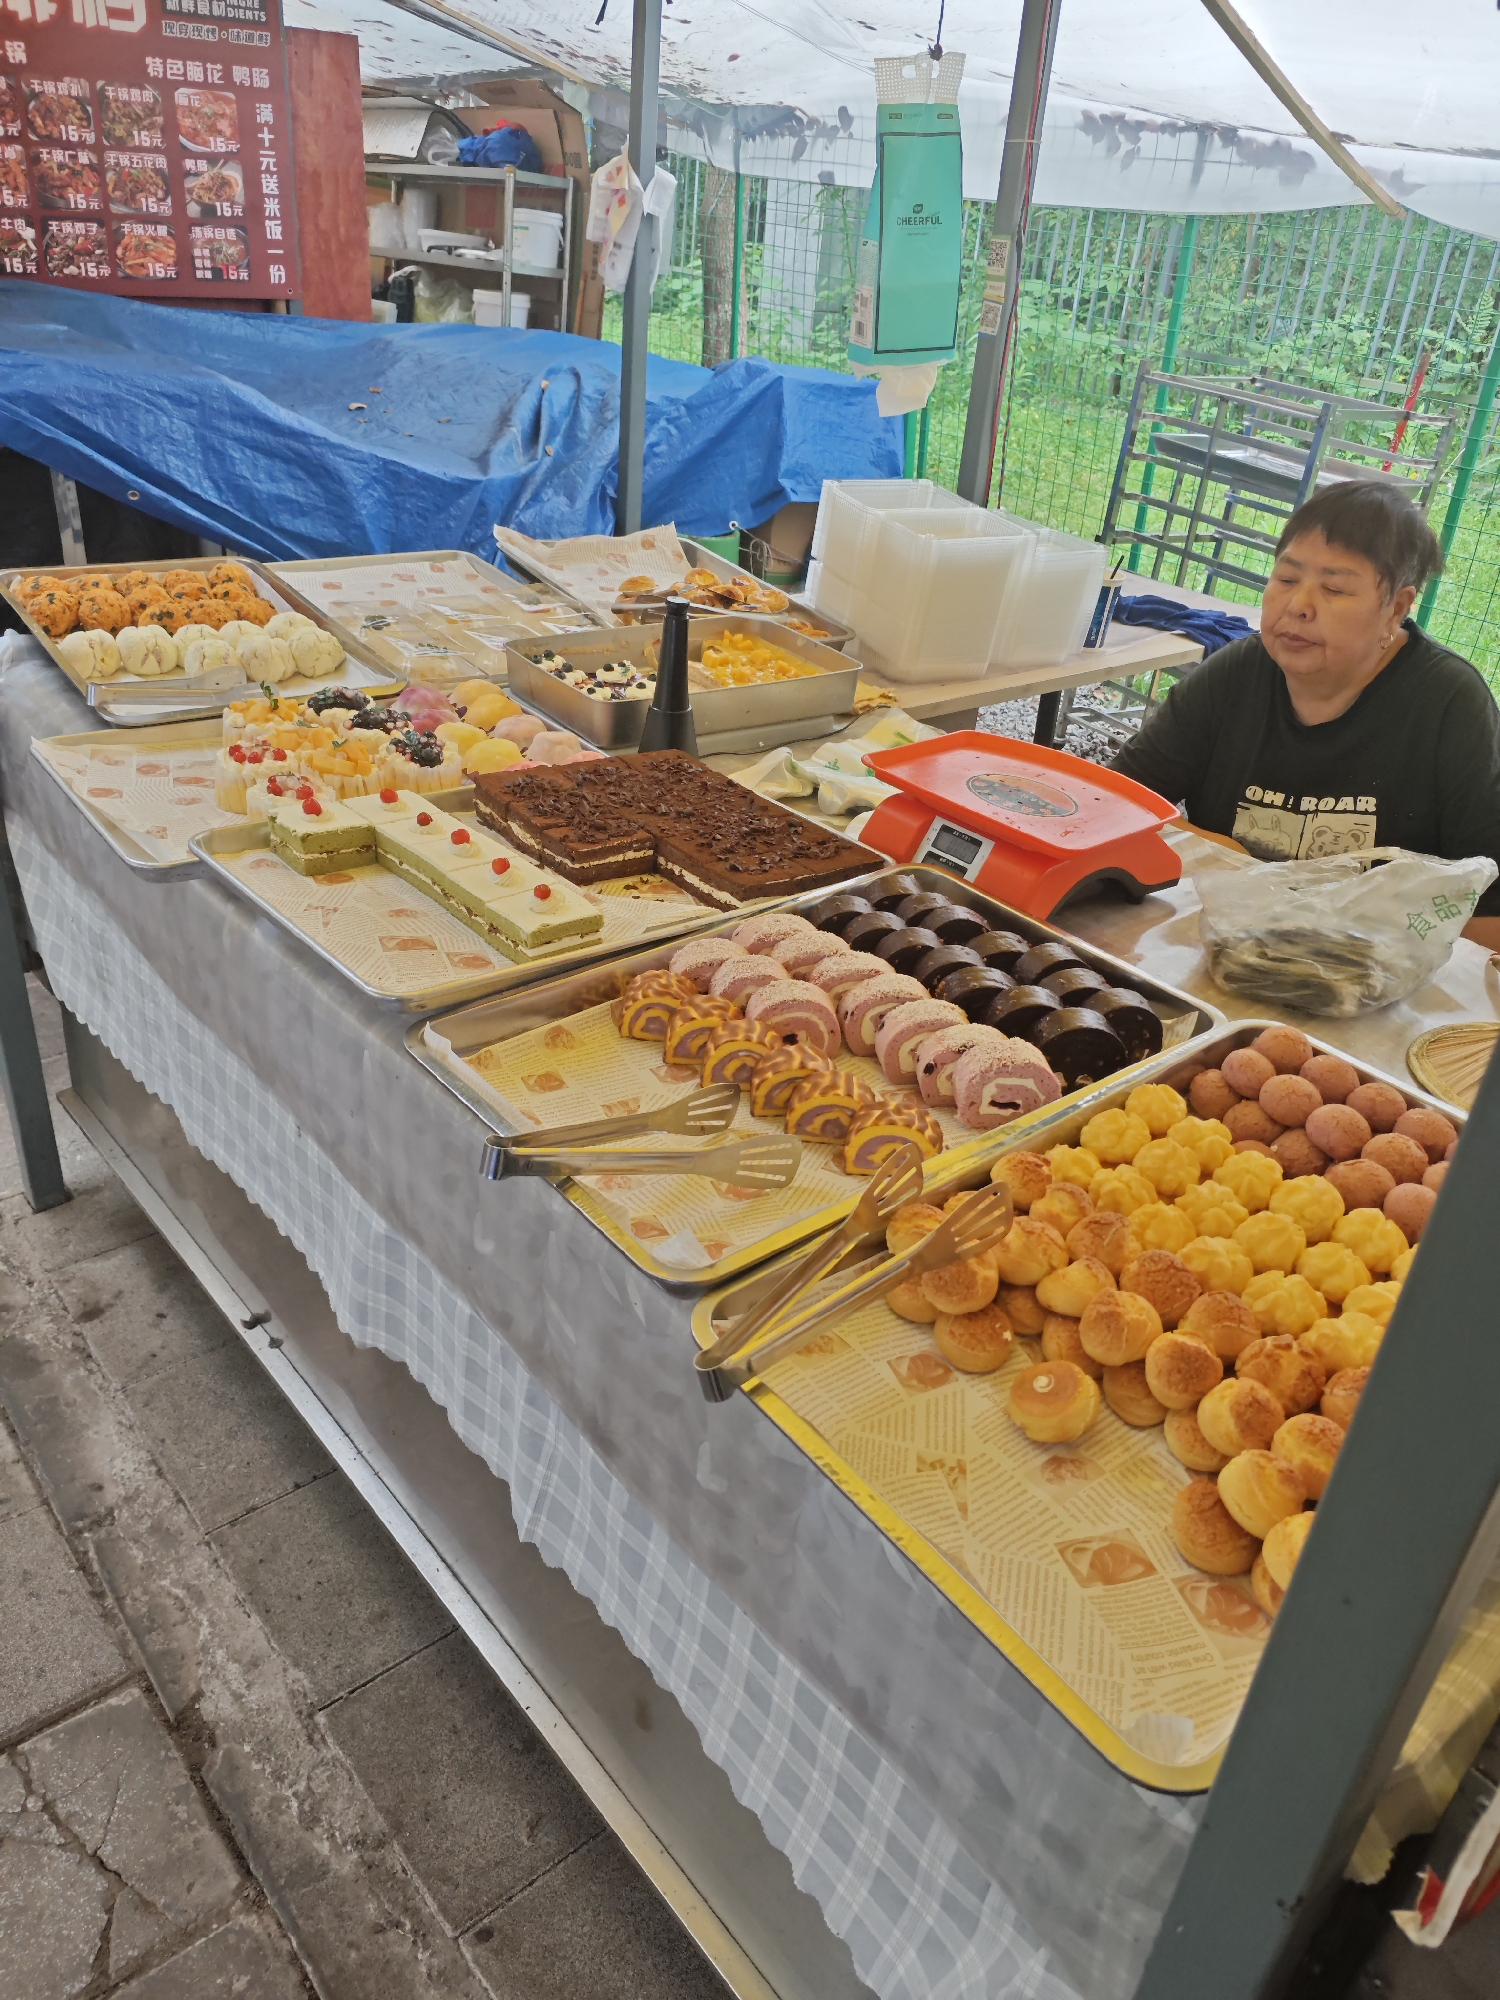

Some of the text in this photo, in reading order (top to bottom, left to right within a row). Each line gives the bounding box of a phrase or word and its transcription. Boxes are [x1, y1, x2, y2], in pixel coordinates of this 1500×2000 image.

[227, 7, 267, 21] DIENTS
[0, 41, 27, 64] 锅
[146, 57, 270, 89] 特色脑花 鸭肠
[105, 86, 154, 103] 干锅鸡肉
[133, 130, 162, 147] 15元
[106, 153, 167, 169] 干锅五花肉
[0, 189, 28, 206] 5元
[68, 193, 101, 209] 15元
[255, 103, 286, 284] 满十元送米饭一份
[140, 197, 169, 213] 15元
[214, 201, 243, 217] 15元
[896, 215, 943, 226] CHEERFUL
[191, 226, 237, 240] 汤锅自选
[4, 257, 38, 274] 15元
[80, 262, 110, 277] 15元
[1300, 796, 1377, 812] ROAR
